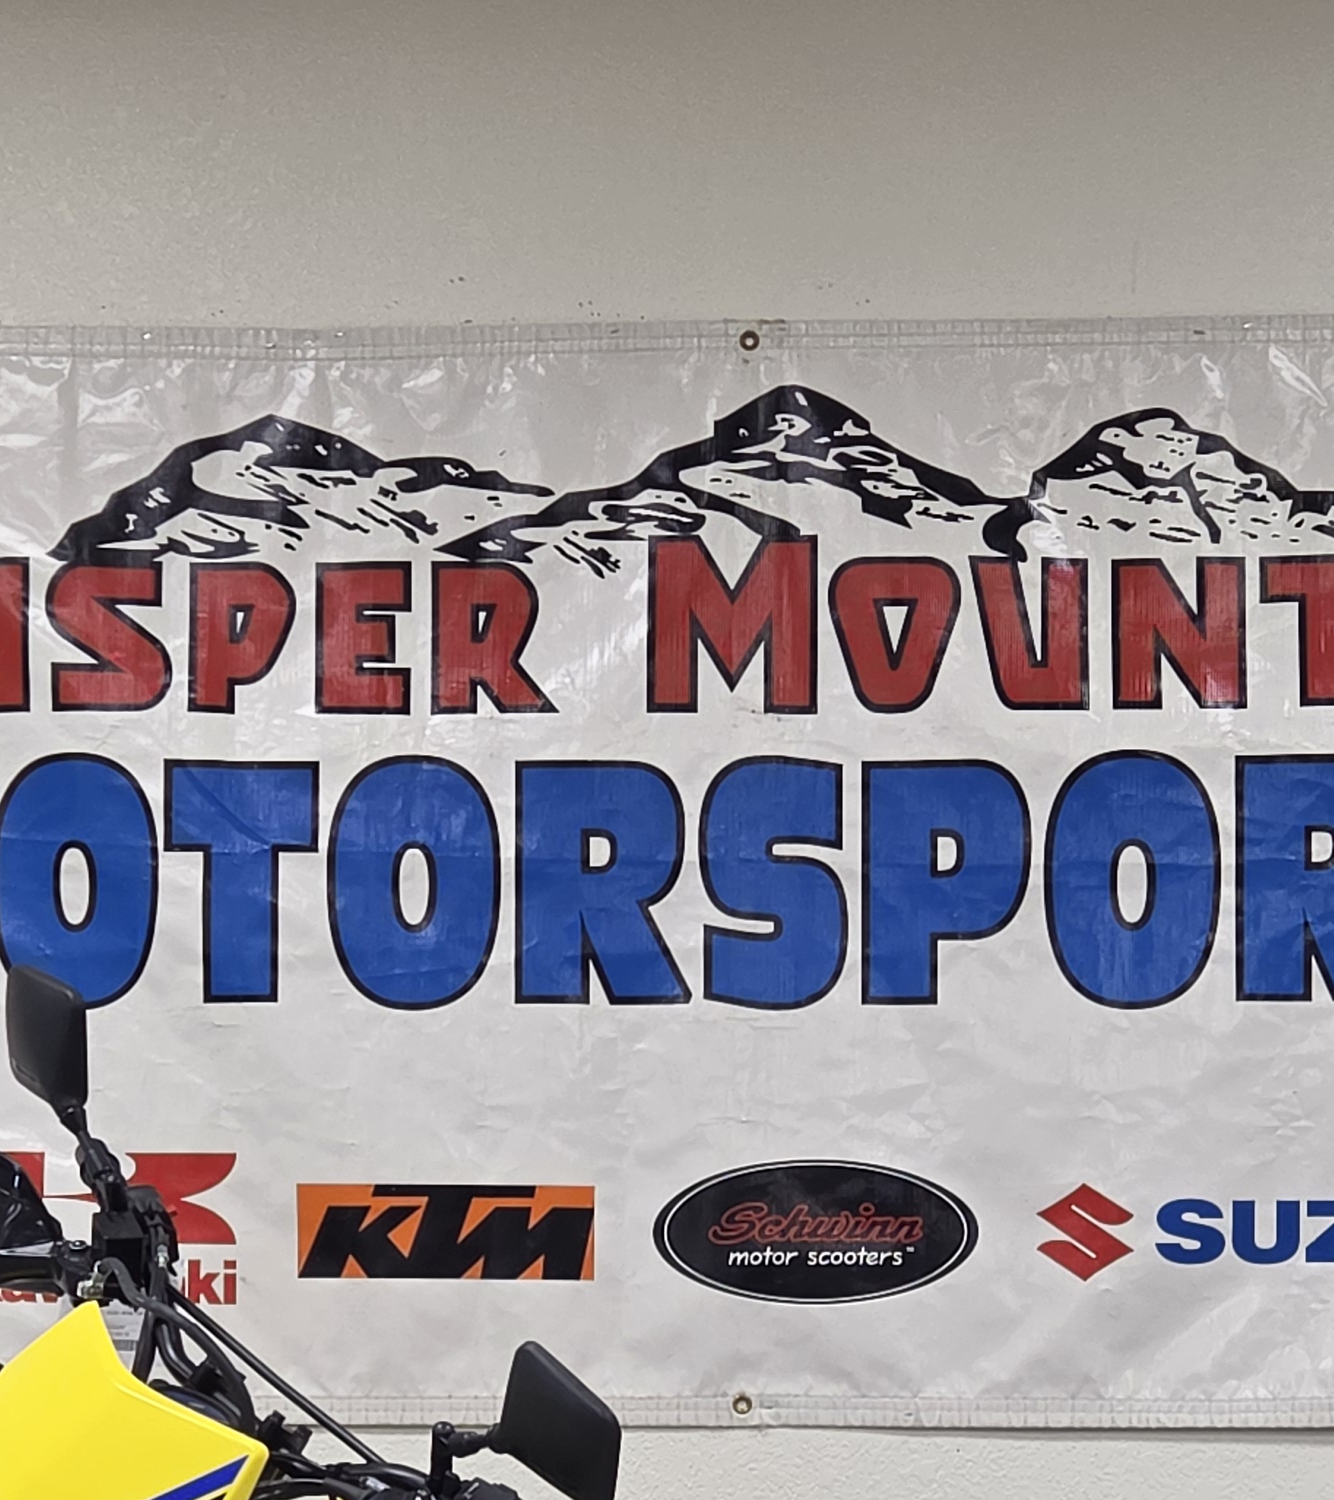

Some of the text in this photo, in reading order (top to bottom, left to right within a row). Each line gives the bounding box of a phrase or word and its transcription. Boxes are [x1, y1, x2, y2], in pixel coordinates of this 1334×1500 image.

[297, 1183, 595, 1280] KTM
[708, 1202, 924, 1245] Schwinn
[728, 1246, 799, 1266] motor
